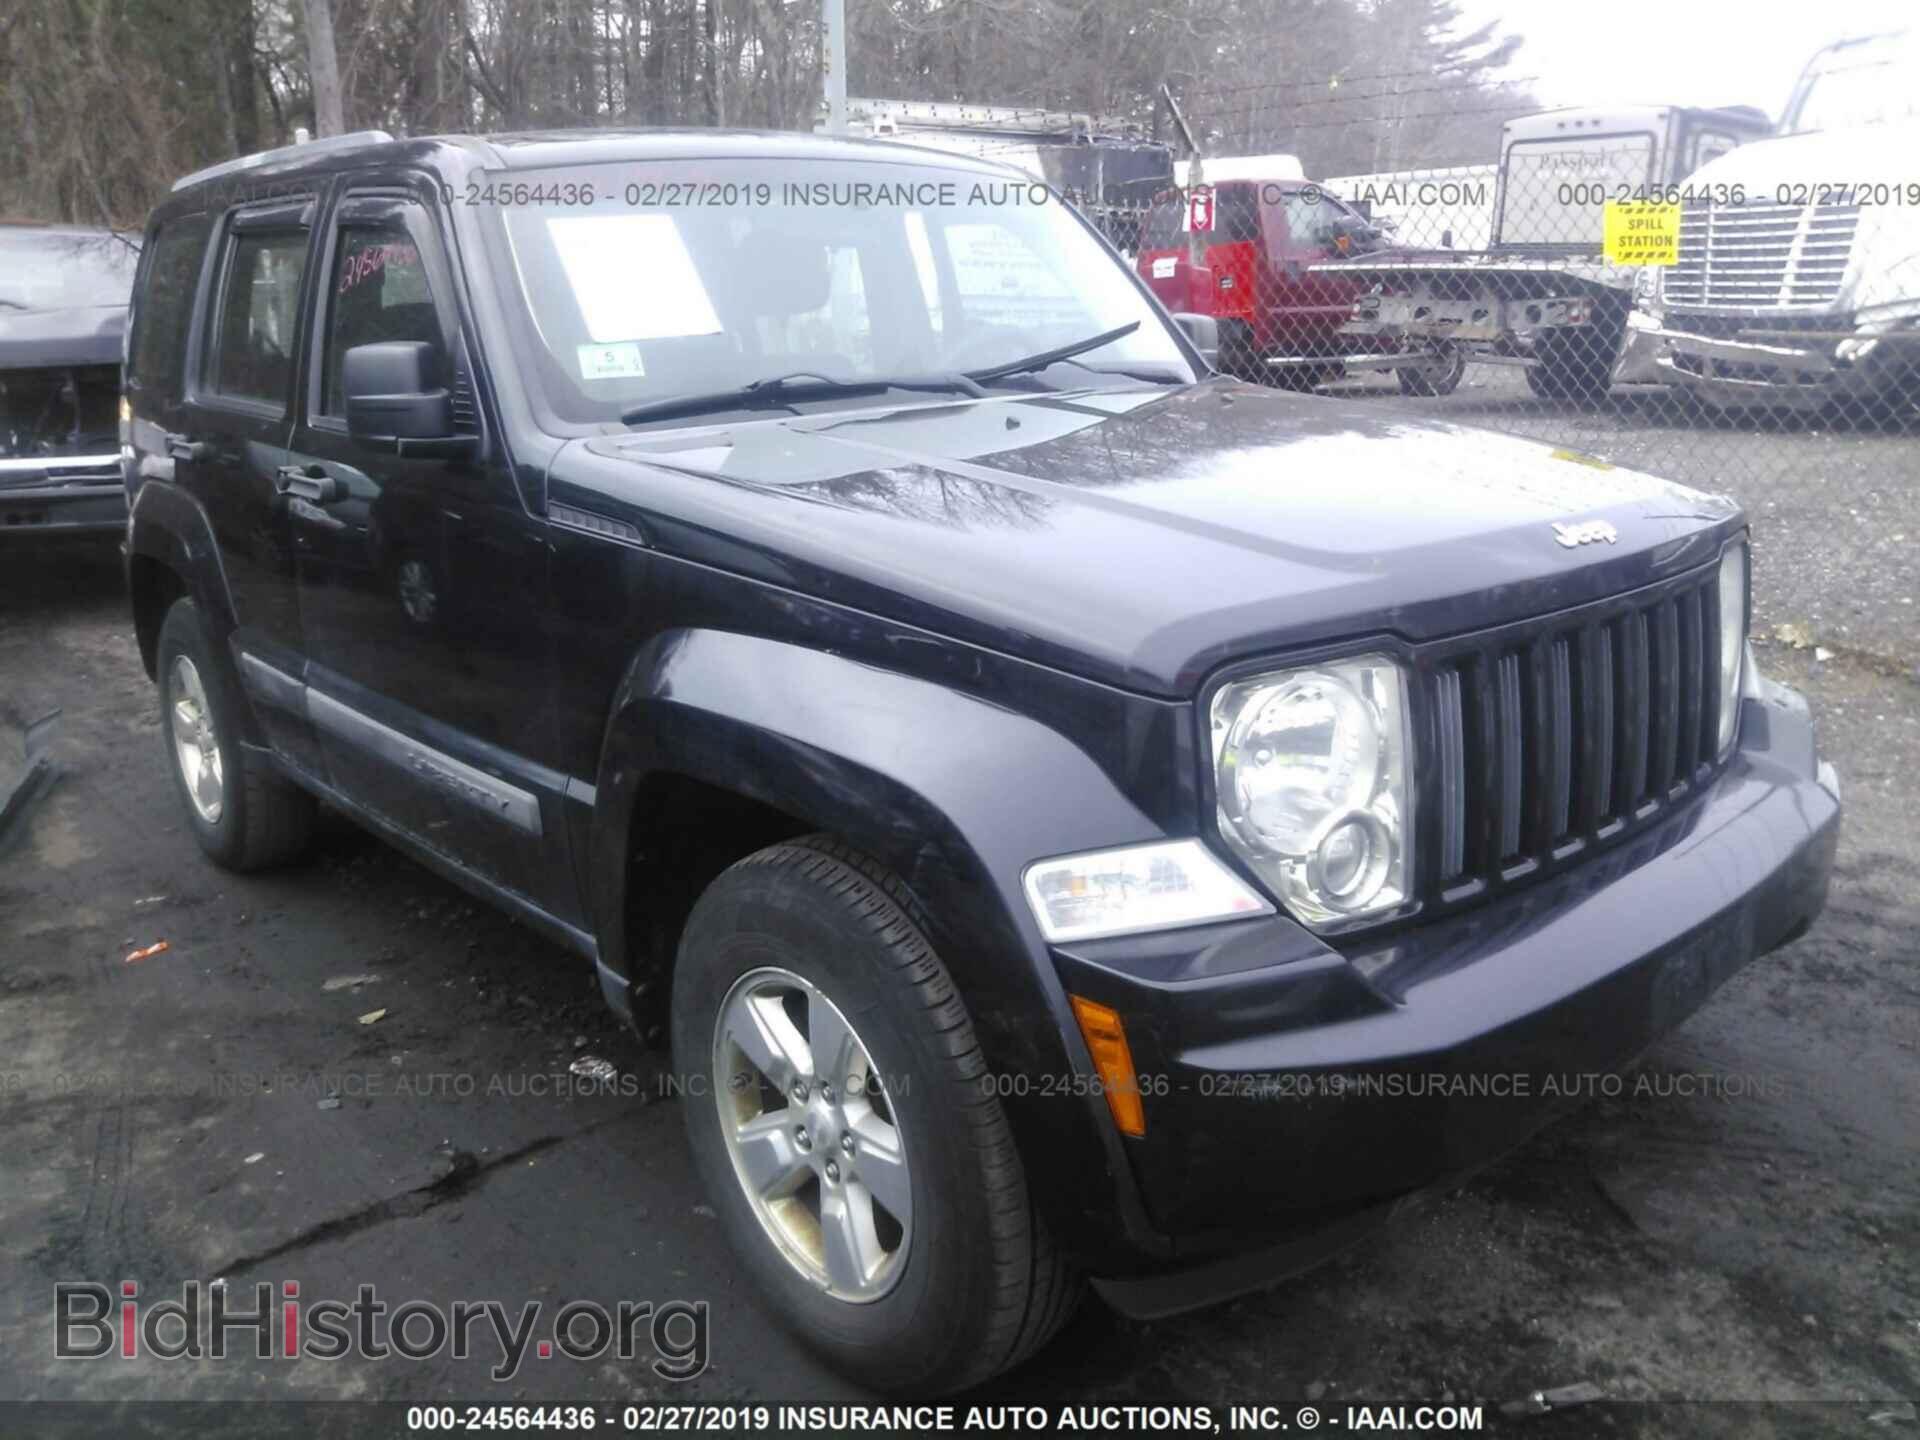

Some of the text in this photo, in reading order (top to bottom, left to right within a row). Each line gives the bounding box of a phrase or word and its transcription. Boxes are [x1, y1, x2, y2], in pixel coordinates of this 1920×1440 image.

[1628, 218, 1665, 231] SPILL
[1618, 235, 1674, 248] STATION
[1551, 520, 1617, 549] Jeep
